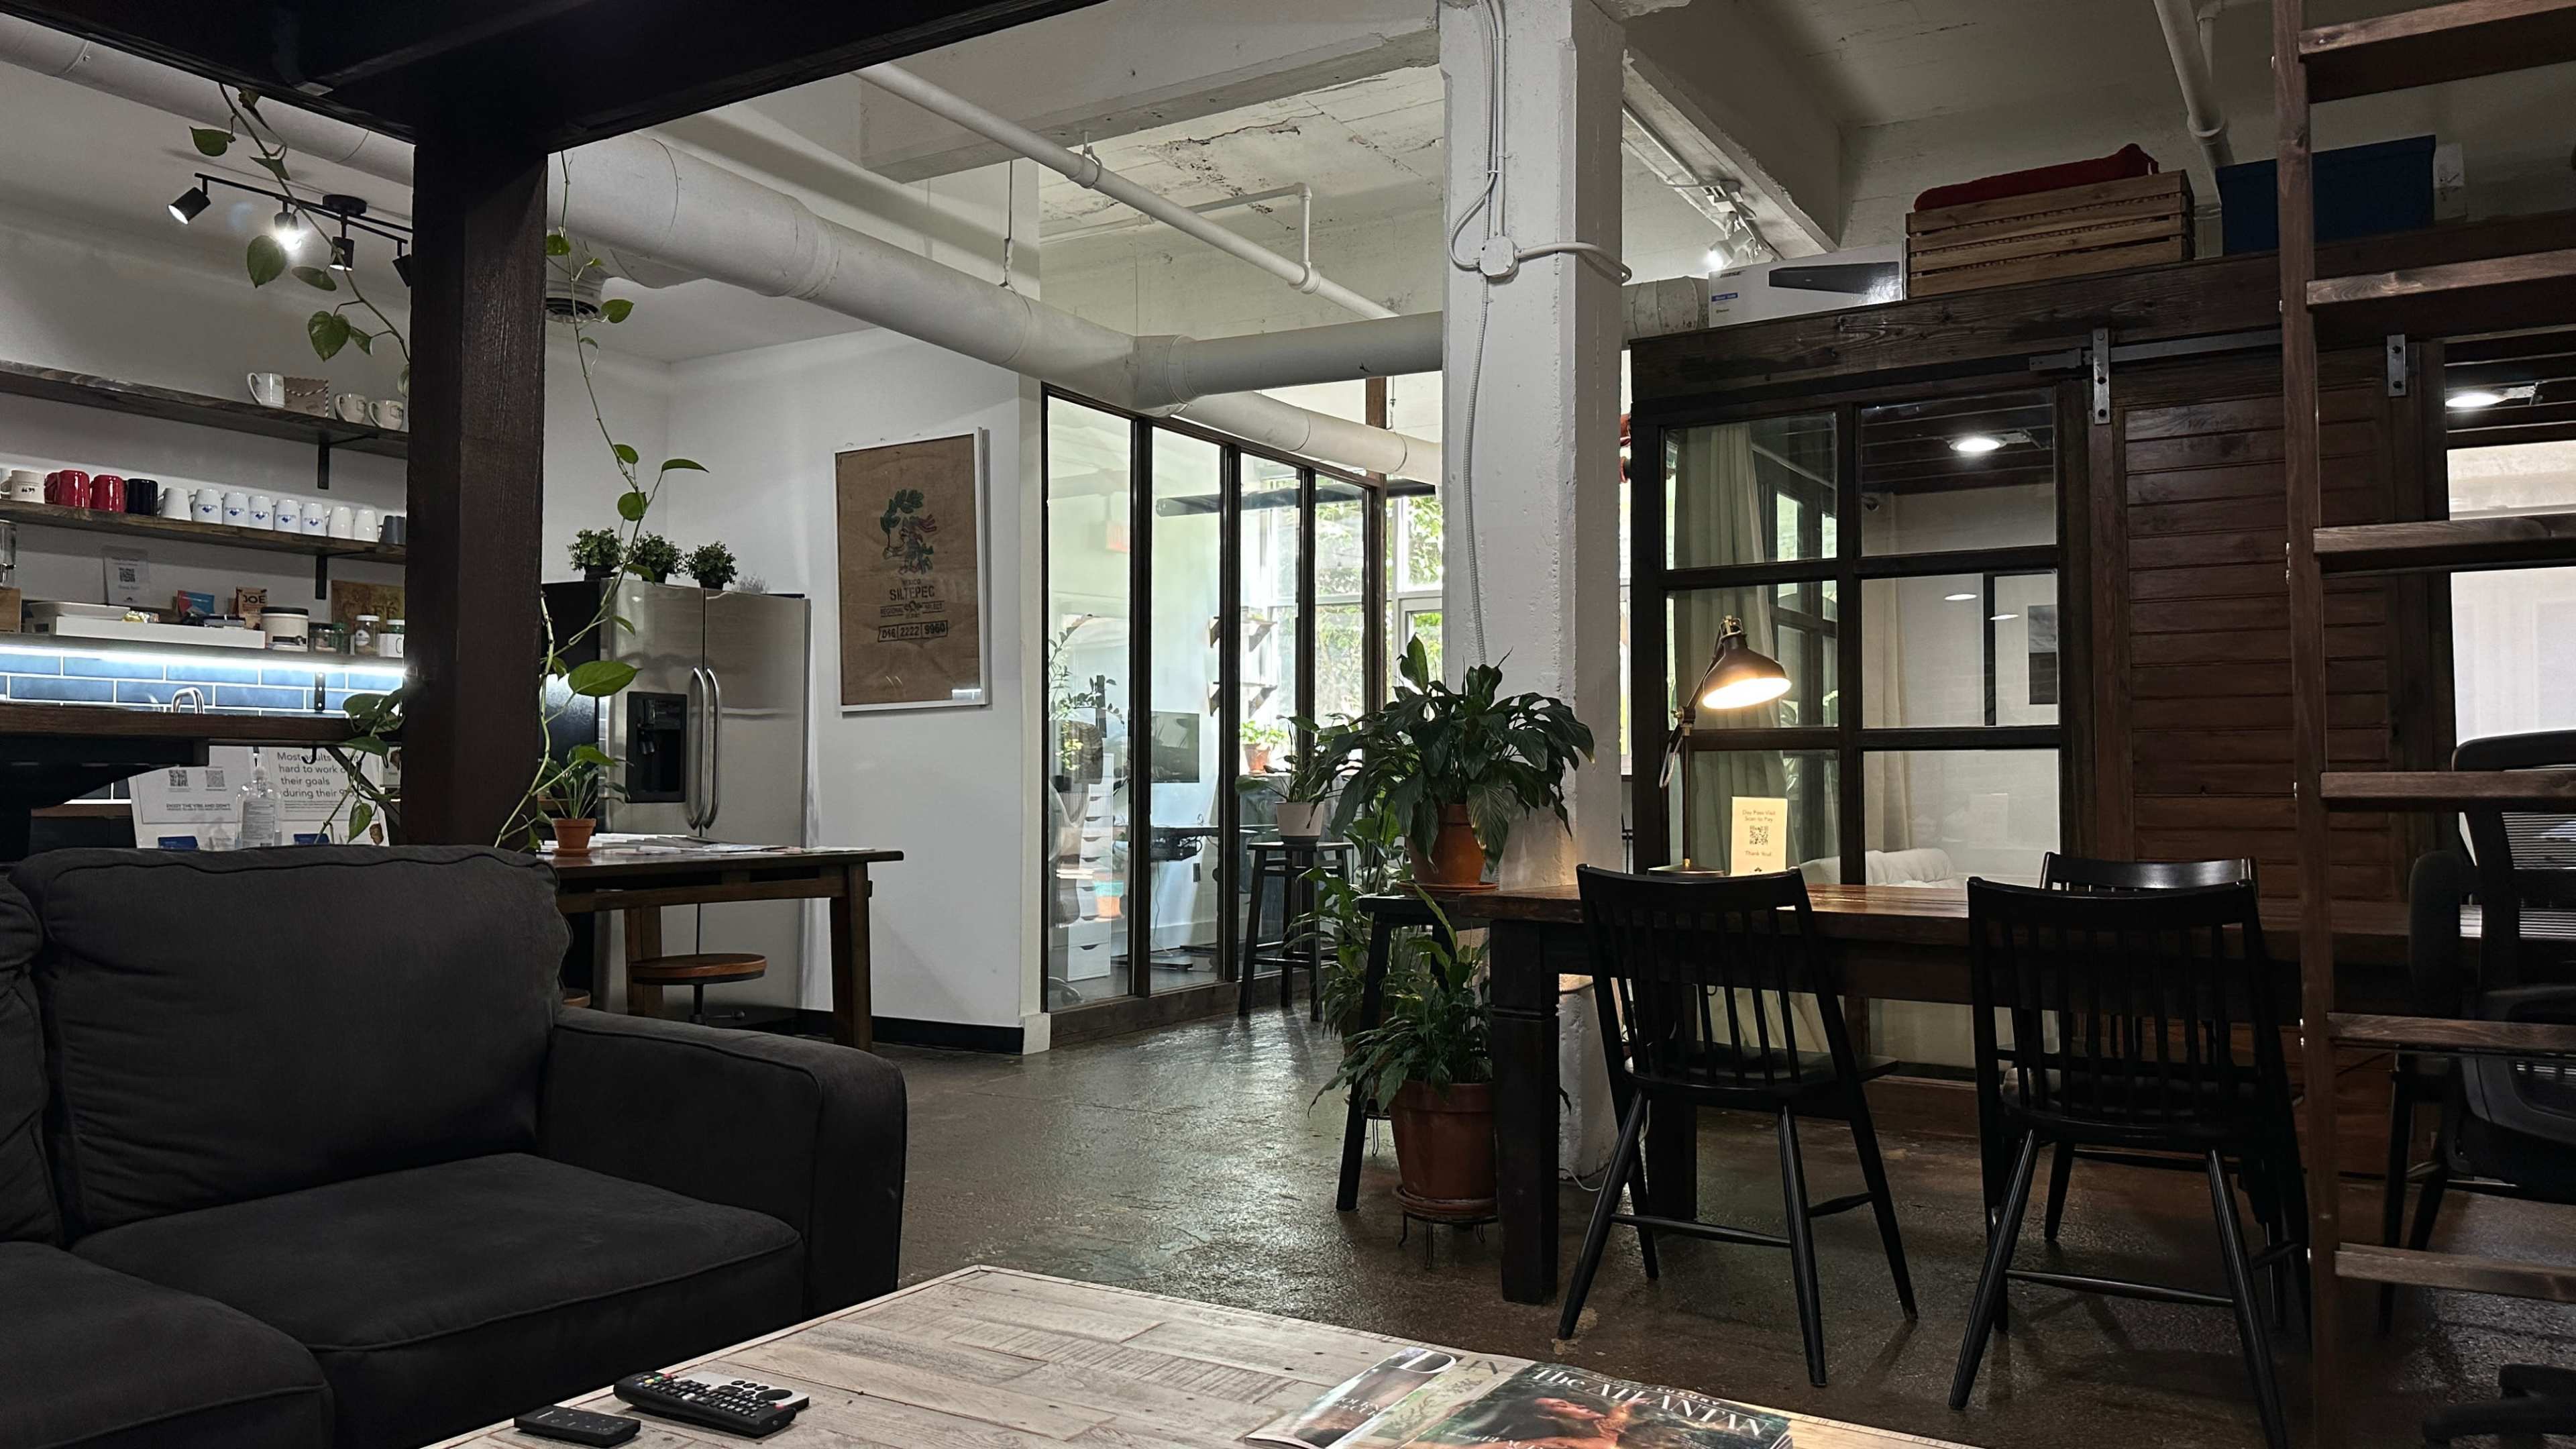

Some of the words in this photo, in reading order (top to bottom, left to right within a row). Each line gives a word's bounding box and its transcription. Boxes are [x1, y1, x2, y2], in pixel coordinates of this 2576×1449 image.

[890, 586, 934, 601] SILTEPEC
[243, 595, 266, 604] JOE
[900, 626, 920, 637] 2222
[277, 752, 303, 761] Most
[303, 752, 331, 761] aults
[279, 765, 300, 773] hard
[315, 765, 338, 773] work
[280, 777, 302, 786] their
[305, 777, 330, 788] goals
[282, 789, 314, 799] during
[315, 788, 336, 797] their
[1656, 1387, 1721, 1406] LUXURY
[1532, 1368, 1585, 1387] The
[1585, 1383, 1771, 1437] ATLANTAN
